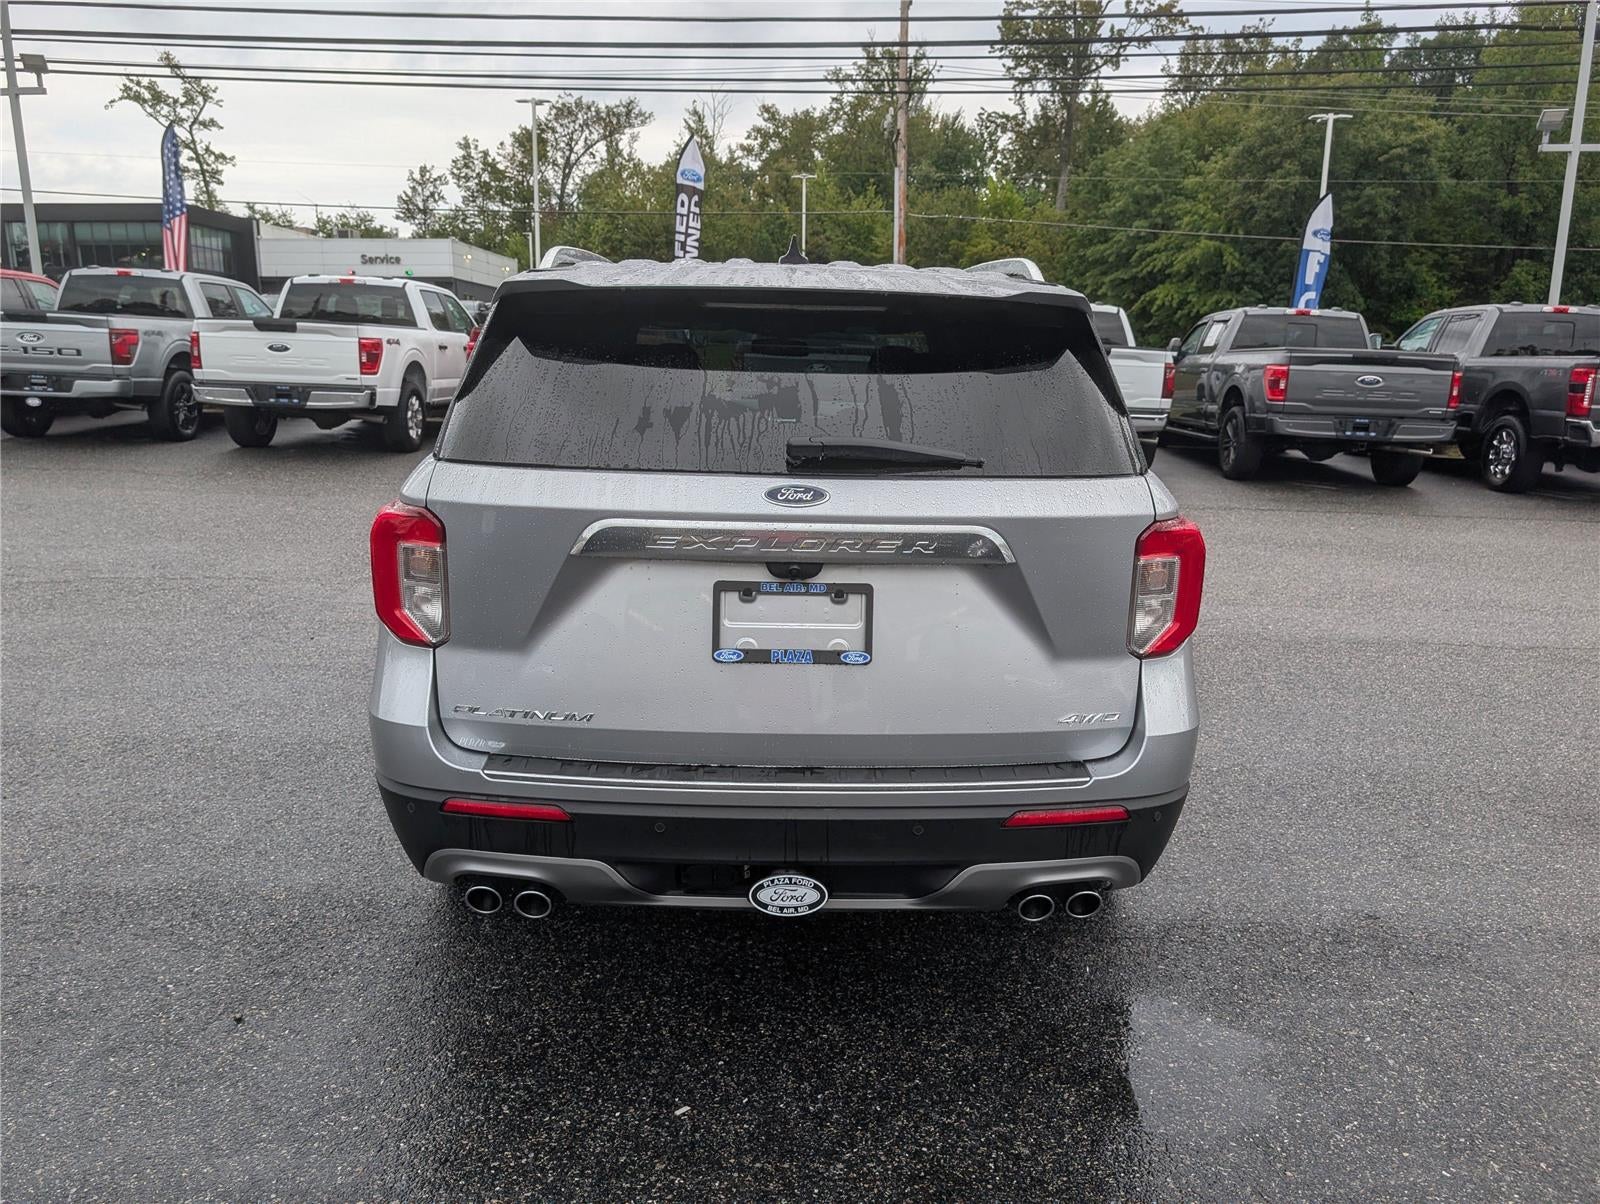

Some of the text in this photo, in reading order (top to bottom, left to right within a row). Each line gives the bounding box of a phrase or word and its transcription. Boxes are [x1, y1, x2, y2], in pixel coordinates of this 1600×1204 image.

[360, 253, 402, 265] Service
[777, 487, 814, 501] Ford
[645, 534, 938, 554] EXPLORER
[760, 582, 783, 592] BEL
[808, 584, 827, 593] MD
[770, 650, 814, 664] PLAZA
[453, 703, 596, 722] PLATINUM
[1057, 711, 1121, 725] 4WD
[763, 877, 815, 889] PLAZA FORD
[769, 887, 808, 903] Ford
[767, 904, 781, 914] BEL
[797, 905, 809, 914] MD
